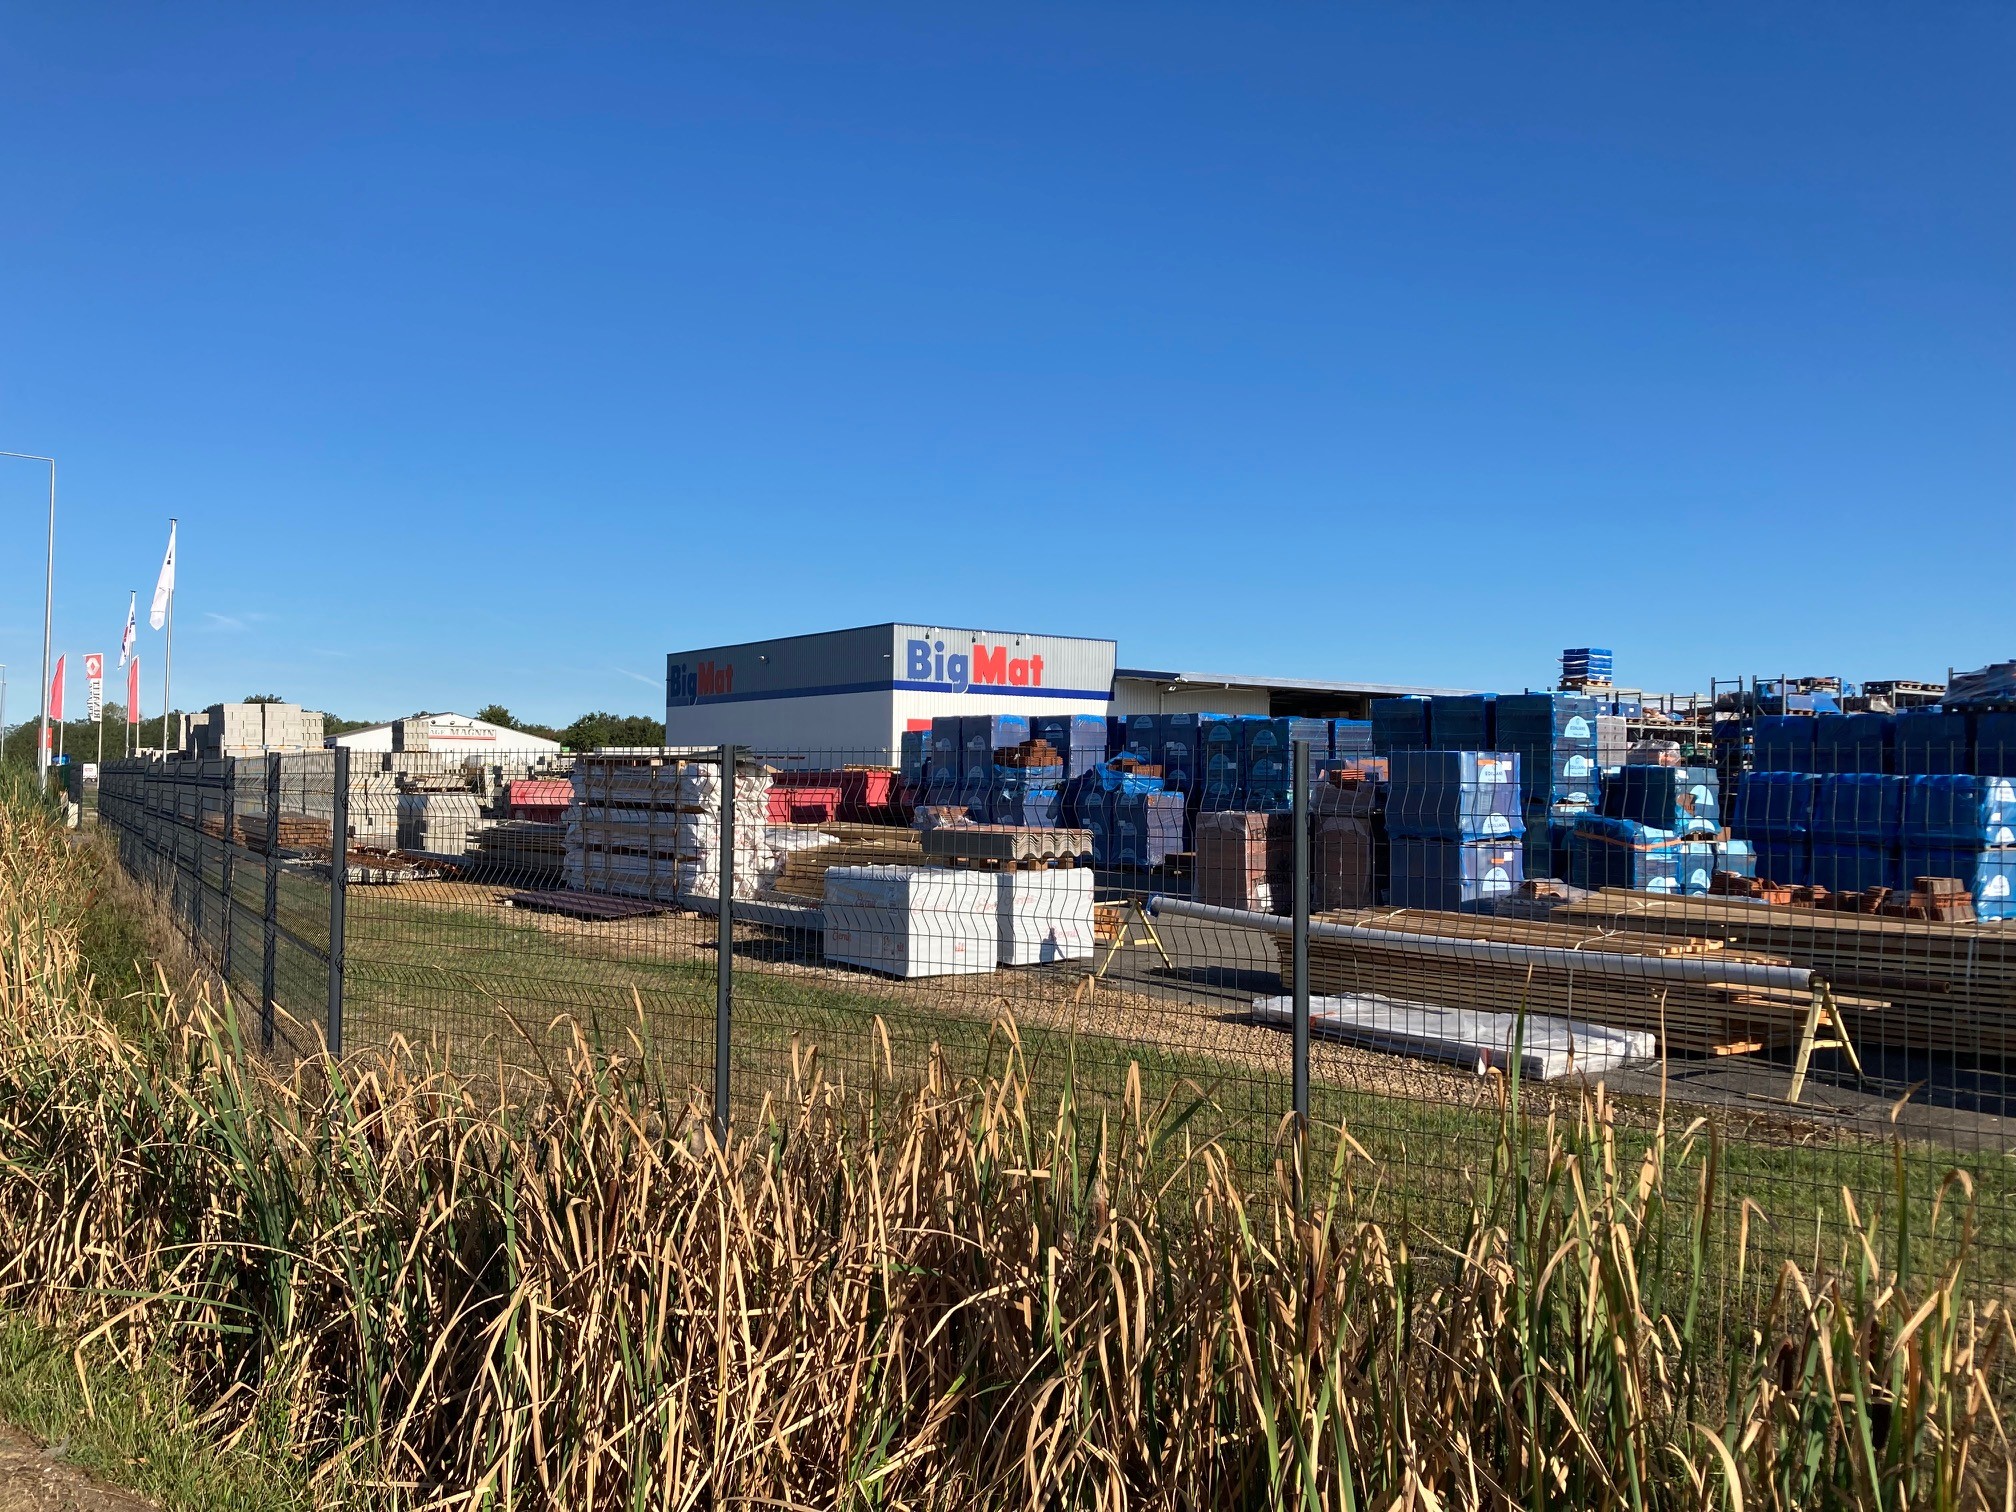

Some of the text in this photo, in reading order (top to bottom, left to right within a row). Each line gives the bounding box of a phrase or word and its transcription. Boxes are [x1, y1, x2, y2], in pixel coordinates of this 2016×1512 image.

[670, 661, 734, 705] BigMat
[907, 639, 1044, 694] BigMat
[450, 728, 495, 736] MAGNIN
